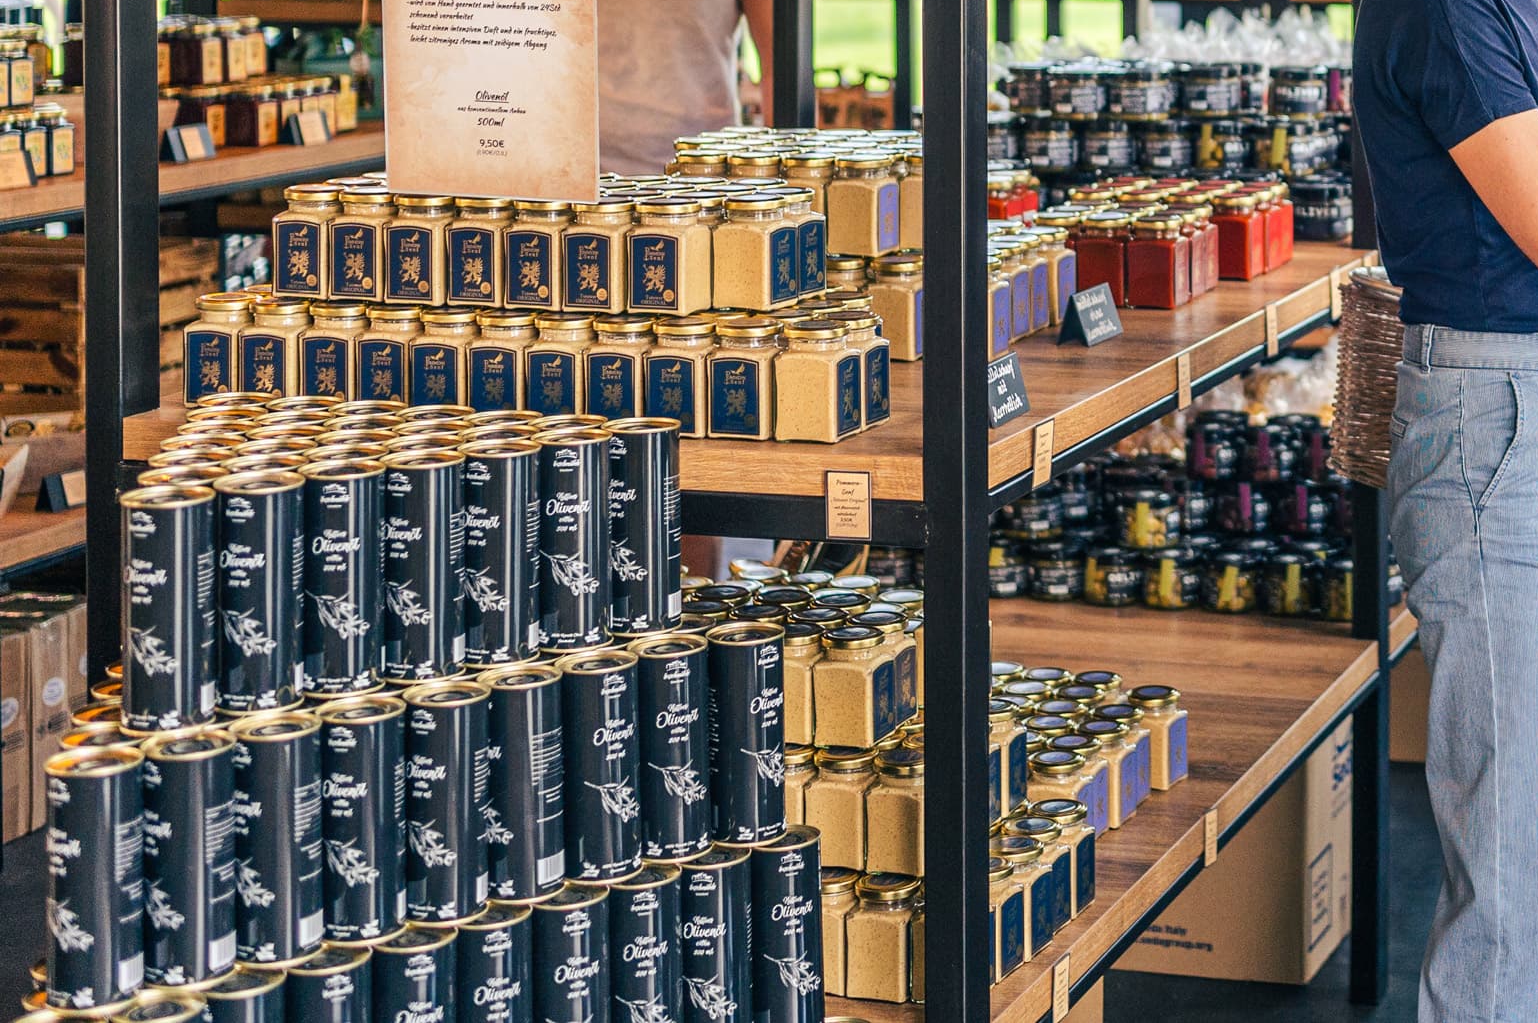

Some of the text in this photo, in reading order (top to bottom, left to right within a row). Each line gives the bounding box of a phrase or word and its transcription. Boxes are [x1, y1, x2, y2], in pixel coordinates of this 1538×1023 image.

[484, 26, 499, 34] Duft
[524, 40, 547, 50] Abgang
[475, 91, 509, 101] Olivenöl
[477, 118, 505, 127] 500ml
[480, 139, 505, 148] 9,50€
[546, 499, 590, 516] Olivenöl
[312, 538, 360, 554] Olivenöl
[656, 708, 699, 729] Olivenöl
[593, 726, 634, 746] Olivenöl
[772, 899, 813, 921] Olivenöl
[683, 922, 727, 939] Olivenöl
[623, 942, 668, 962] Olivenöl
[554, 962, 600, 984] Olivenöl
